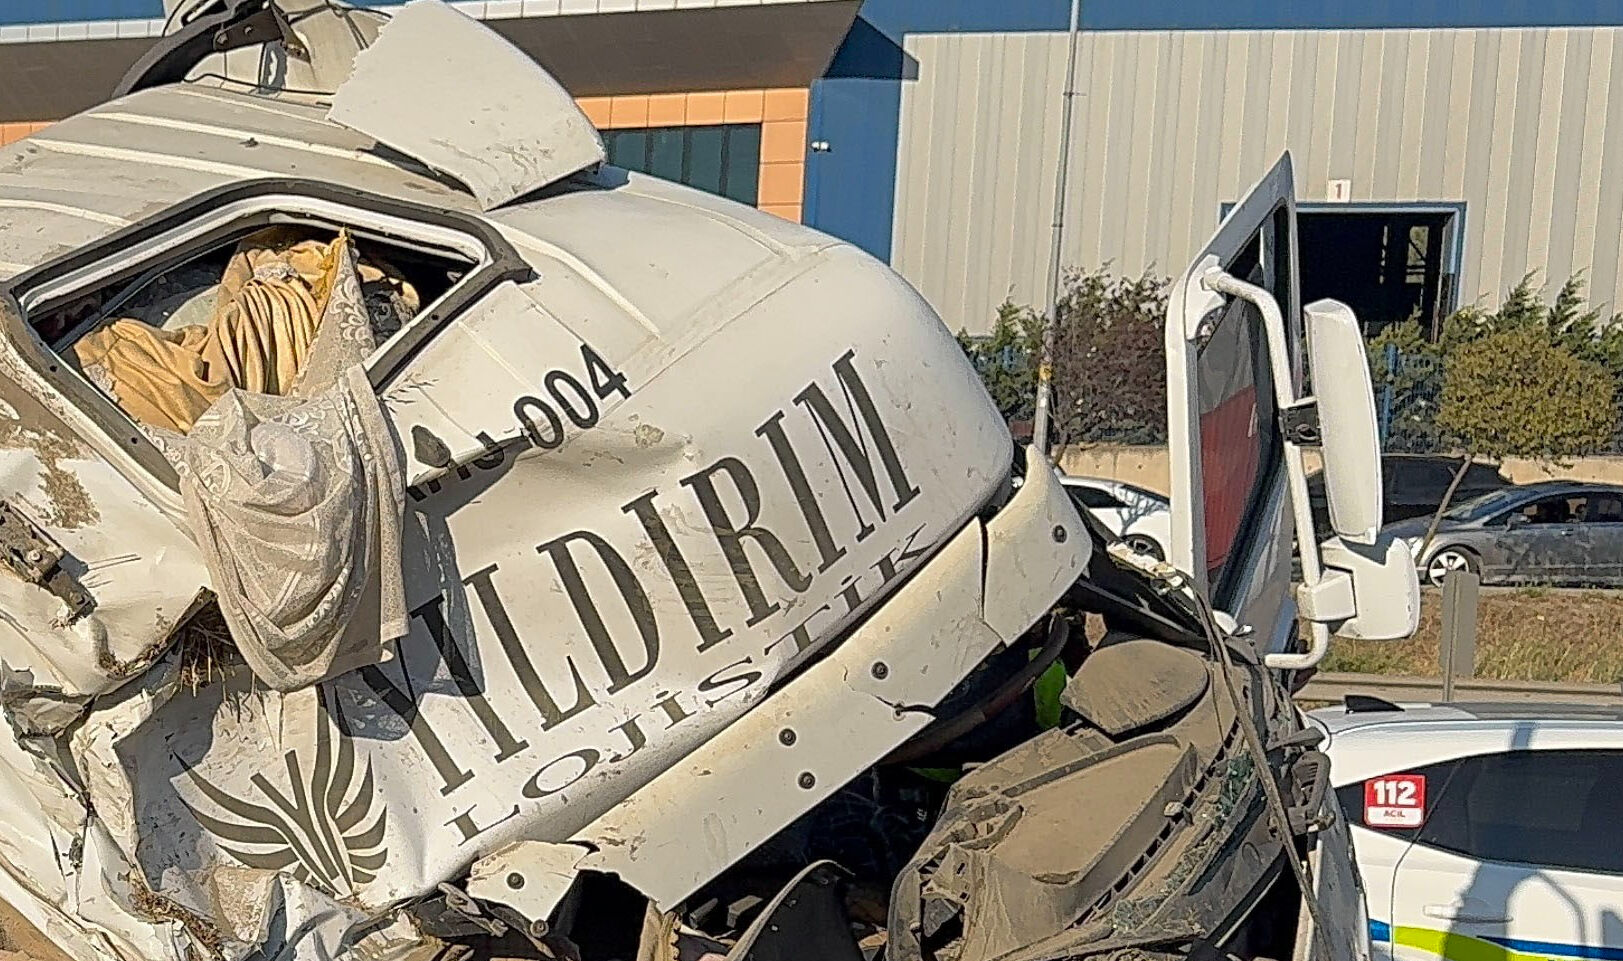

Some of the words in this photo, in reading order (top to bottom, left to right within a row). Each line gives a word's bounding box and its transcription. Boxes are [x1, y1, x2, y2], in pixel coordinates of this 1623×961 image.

[1335, 183, 1342, 199] 1
[513, 342, 632, 449] 004
[357, 348, 922, 797] YILDIRIM
[1374, 780, 1416, 805] 112
